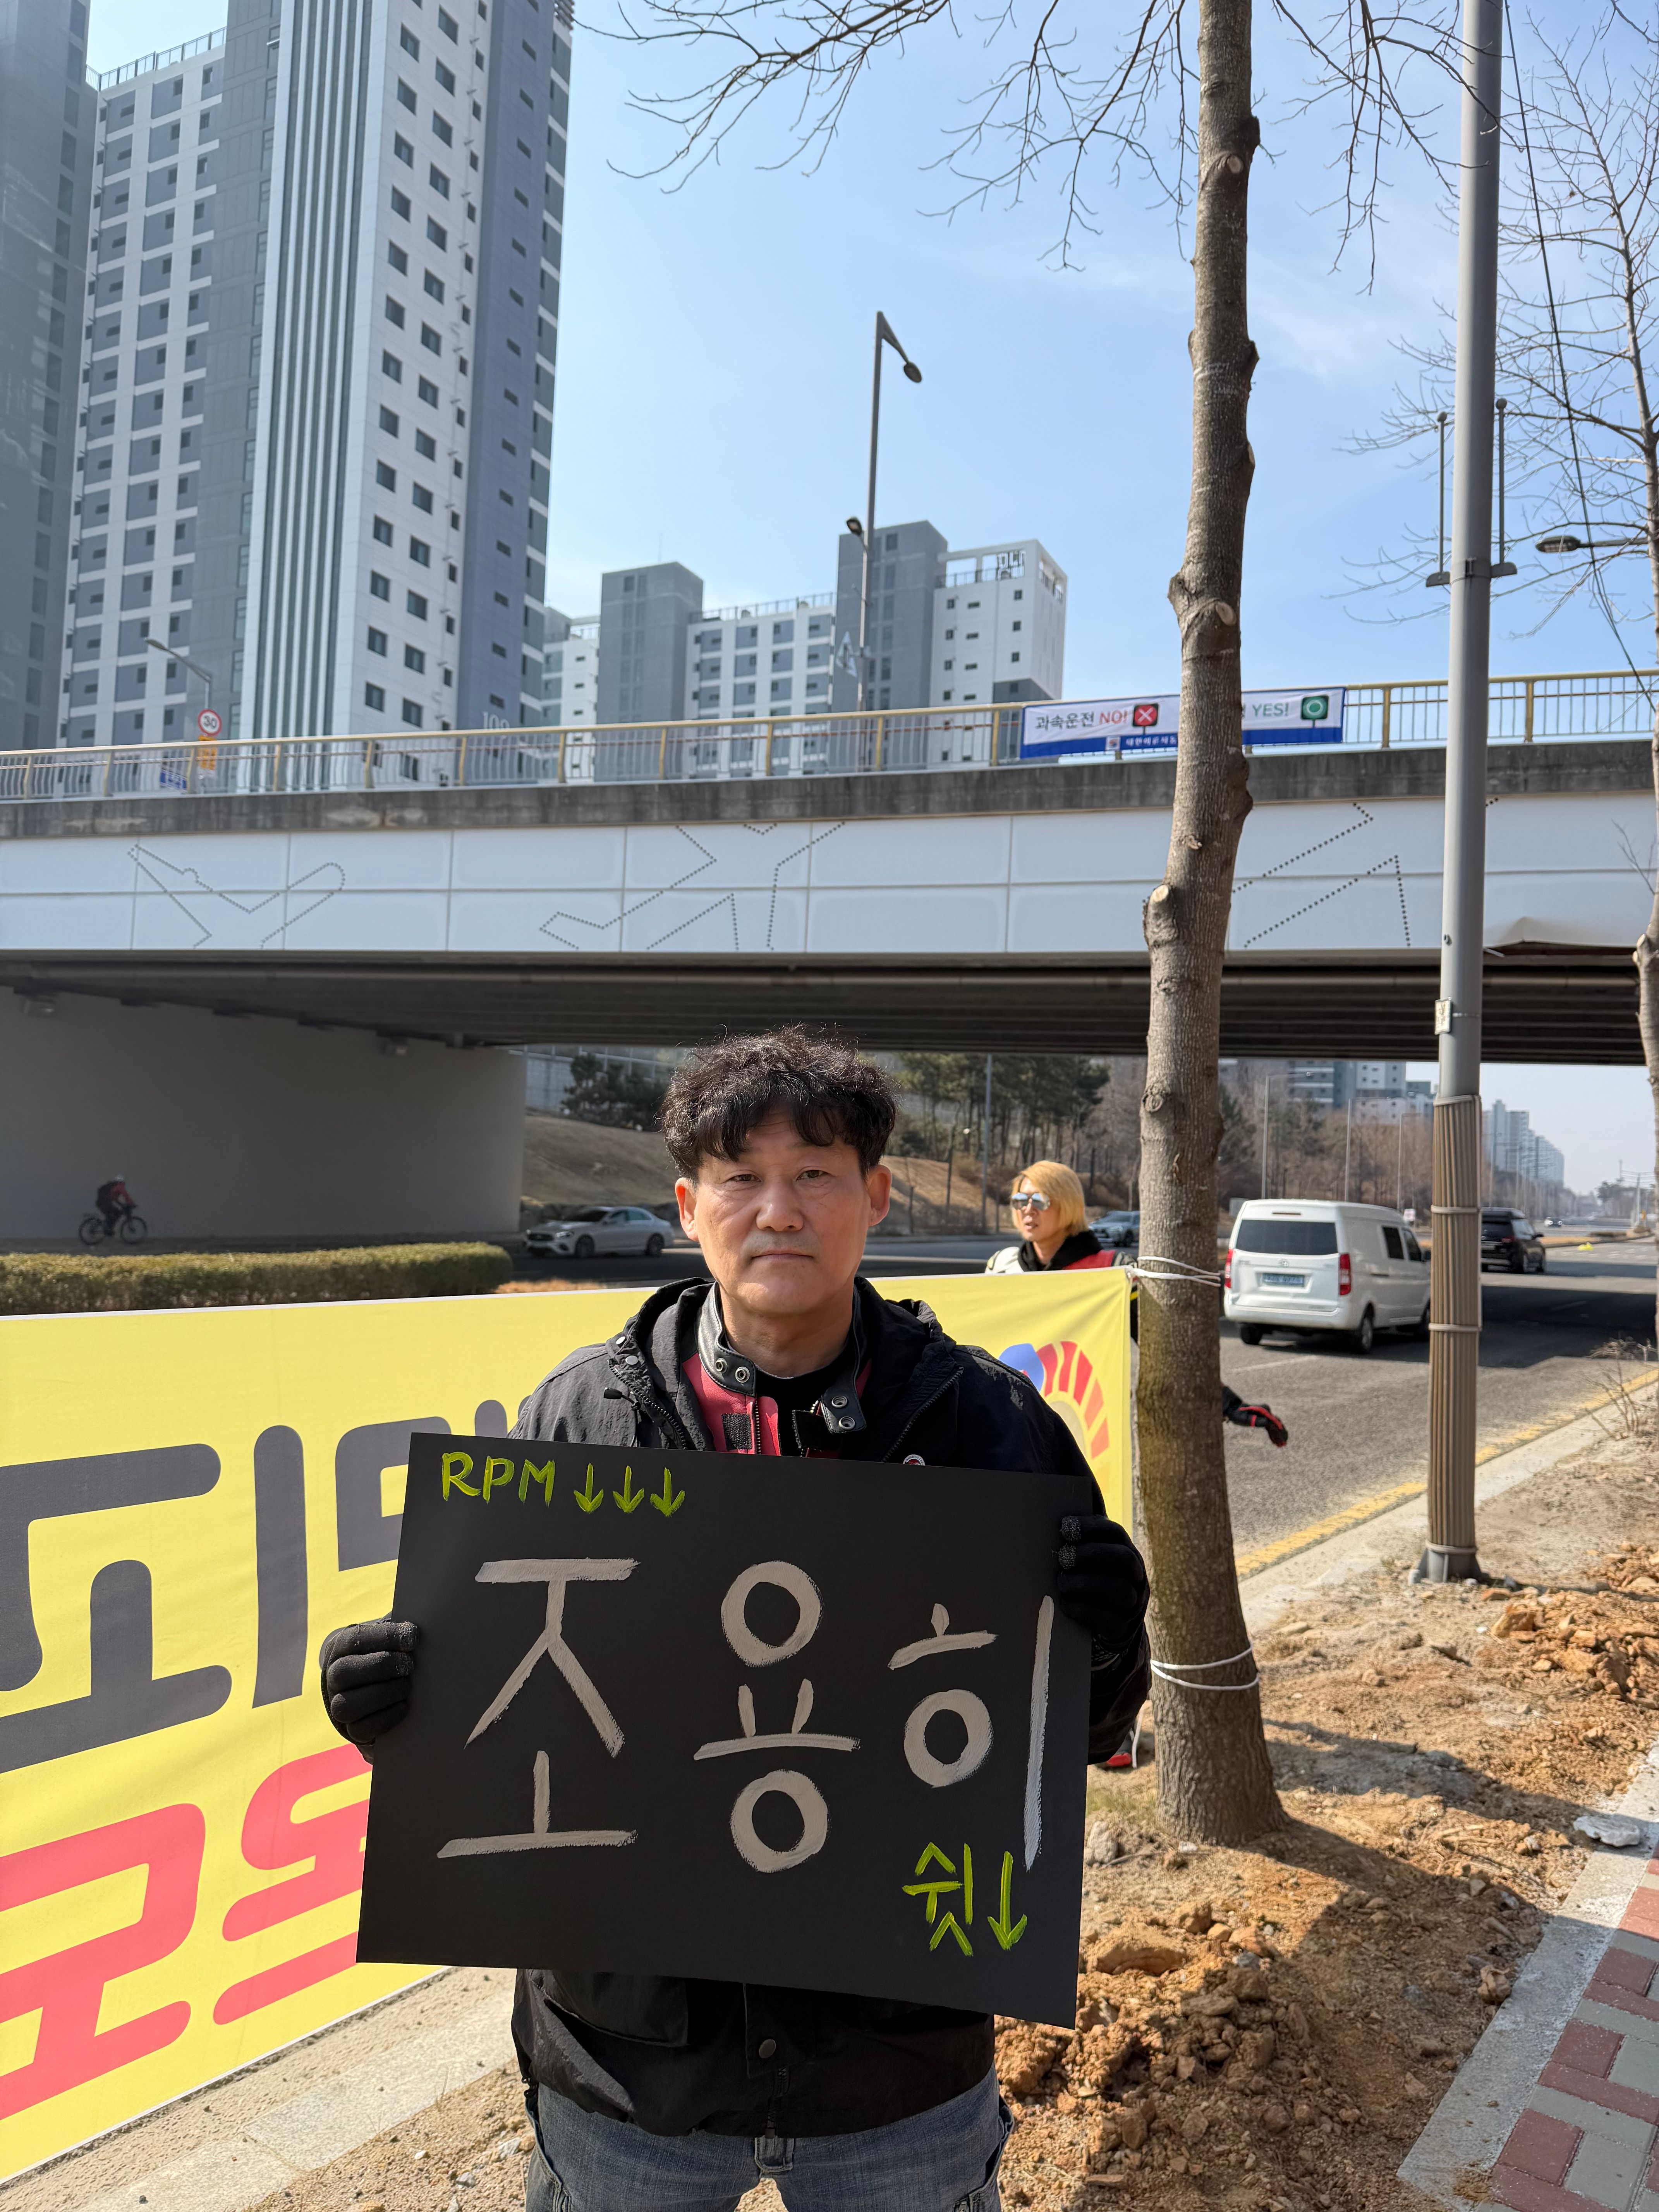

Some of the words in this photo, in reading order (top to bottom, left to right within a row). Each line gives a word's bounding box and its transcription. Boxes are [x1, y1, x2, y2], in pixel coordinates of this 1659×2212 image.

[203, 715, 218, 729] 30
[1036, 711, 1094, 731] 과속운전
[1099, 710, 1128, 725] NO!
[1252, 702, 1289, 717] YES!
[441, 1451, 555, 1506] RPM
[437, 1558, 1054, 1872] 조용히
[902, 1841, 974, 1956] 쉿
